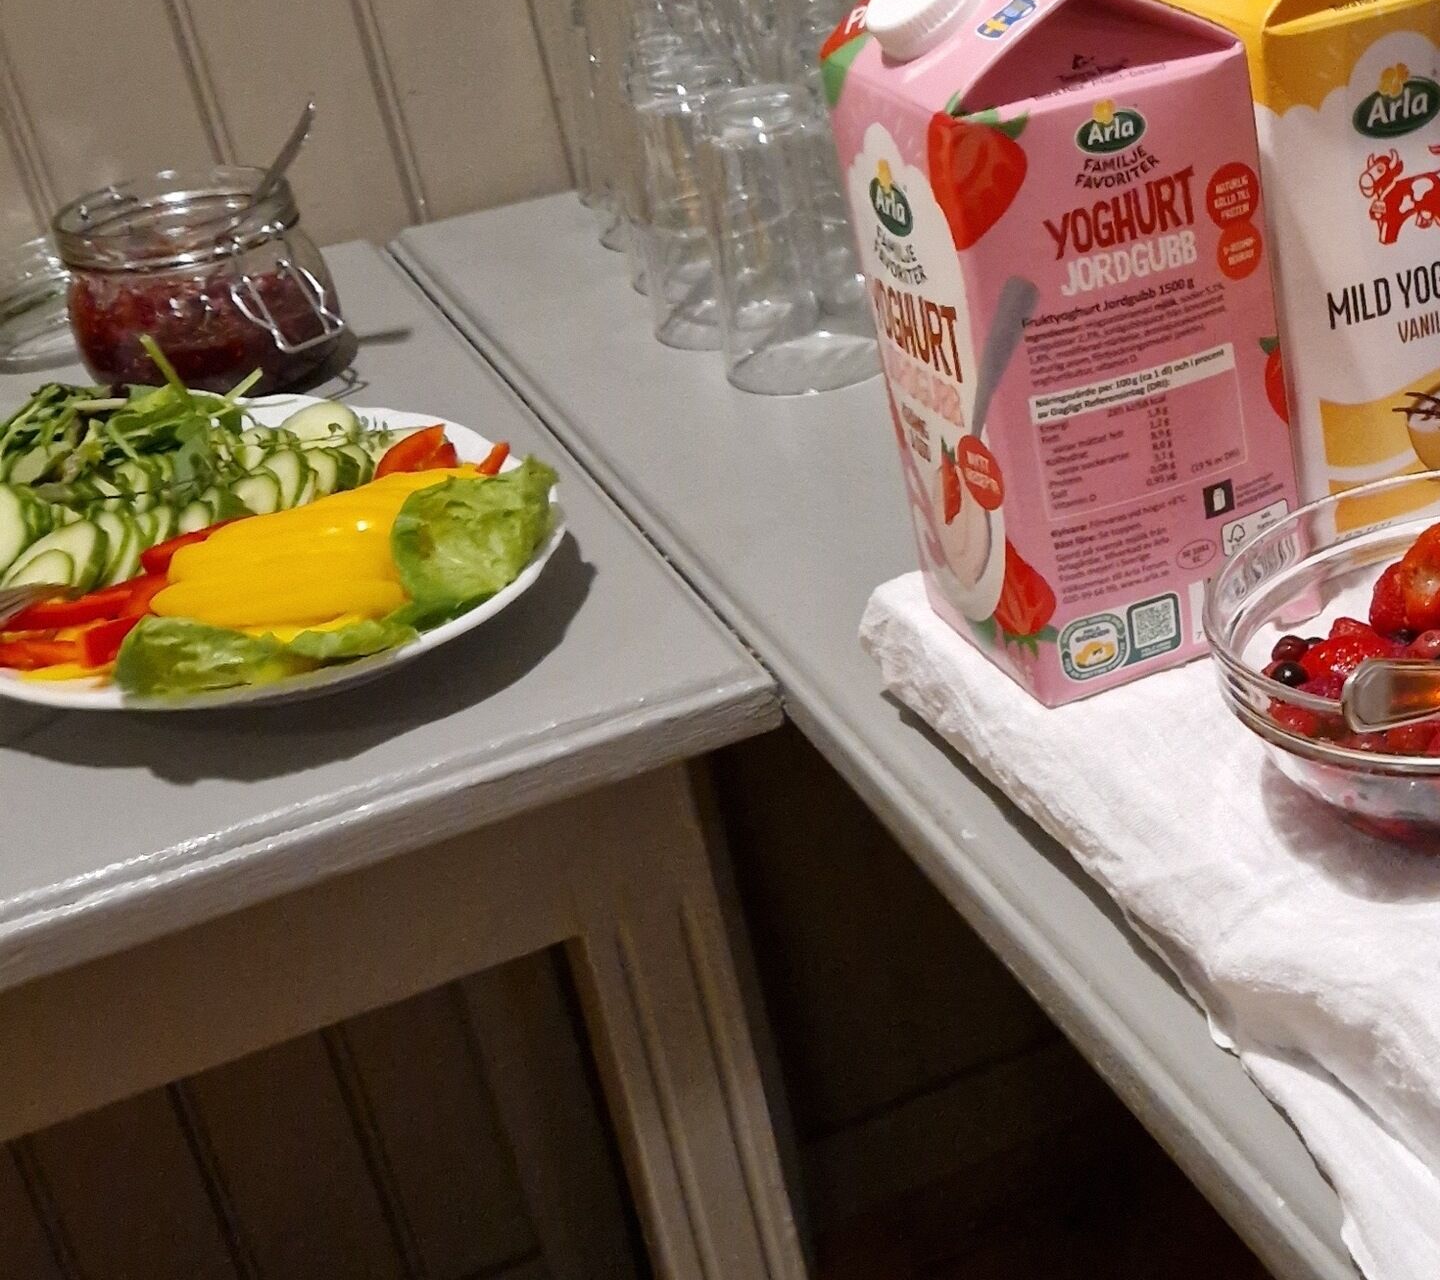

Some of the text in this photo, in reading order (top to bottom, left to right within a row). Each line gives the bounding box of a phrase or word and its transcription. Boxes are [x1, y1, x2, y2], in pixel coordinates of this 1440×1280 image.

[1367, 88, 1429, 128] Arla
[1087, 117, 1135, 146] Arla
[1074, 156, 1160, 190] FAVORITER
[1083, 145, 1148, 171] FAMILJE
[1043, 166, 1196, 261] YOGHURT
[1060, 230, 1198, 297] JORDGUBB
[1104, 288, 1155, 309] Jordgubb
[1159, 279, 1184, 295] 1500
[1186, 277, 1195, 290] g
[1327, 276, 1392, 330] MILD
